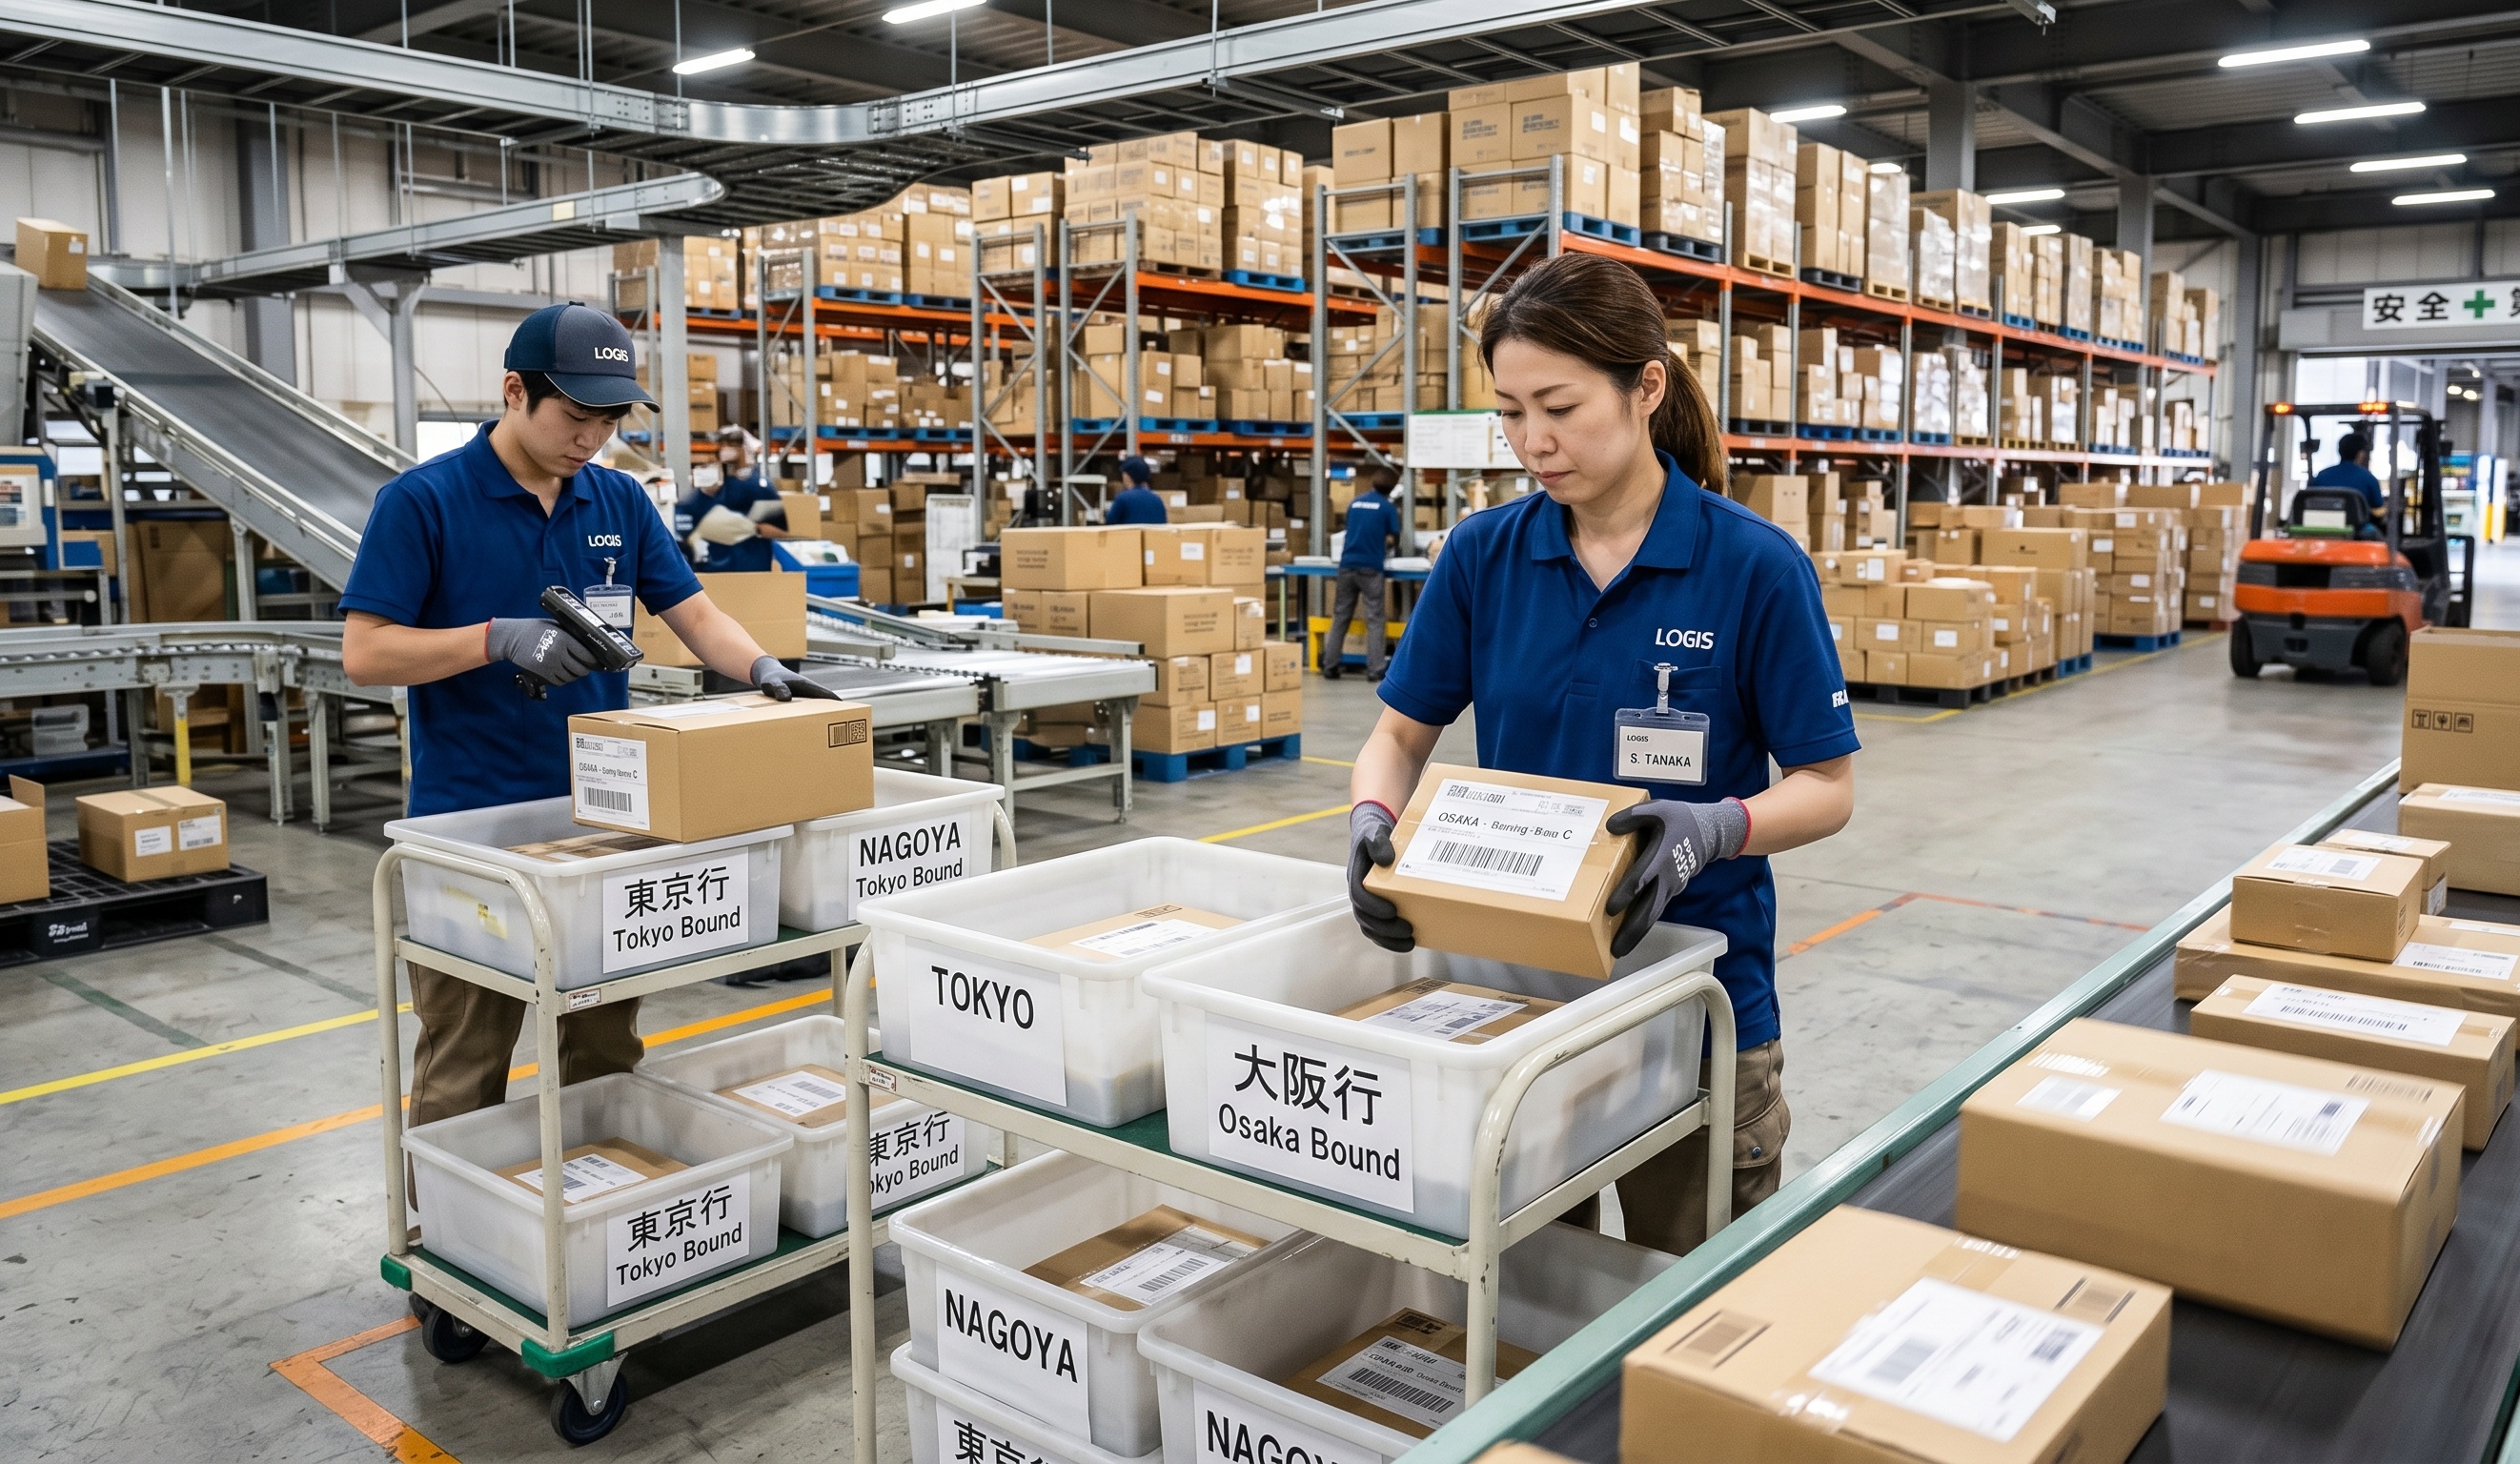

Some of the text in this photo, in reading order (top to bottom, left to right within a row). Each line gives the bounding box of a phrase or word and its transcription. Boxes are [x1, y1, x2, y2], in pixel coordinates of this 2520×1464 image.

[2373, 292, 2449, 323] 安全
[1655, 628, 1715, 650] LOGIS
[1630, 752, 1692, 767] S. TANAKA
[860, 822, 962, 867] NAGOYA
[1562, 829, 1573, 840] C
[624, 865, 730, 920] 東京行
[856, 857, 963, 898] Tokyo Bound
[612, 905, 741, 952] Tokyo Bound
[930, 965, 1034, 1030] TOKYO
[1234, 1043, 1382, 1126] 大阪行
[869, 1110, 950, 1167] 東京行
[909, 1143, 959, 1181] Bound
[1218, 1103, 1400, 1182] Osaka Bound
[627, 1185, 733, 1252] 東京行
[616, 1221, 742, 1286] Tokyo Bound
[945, 1288, 1078, 1384] NAGOYA
[1207, 1409, 1338, 1464] NAG
